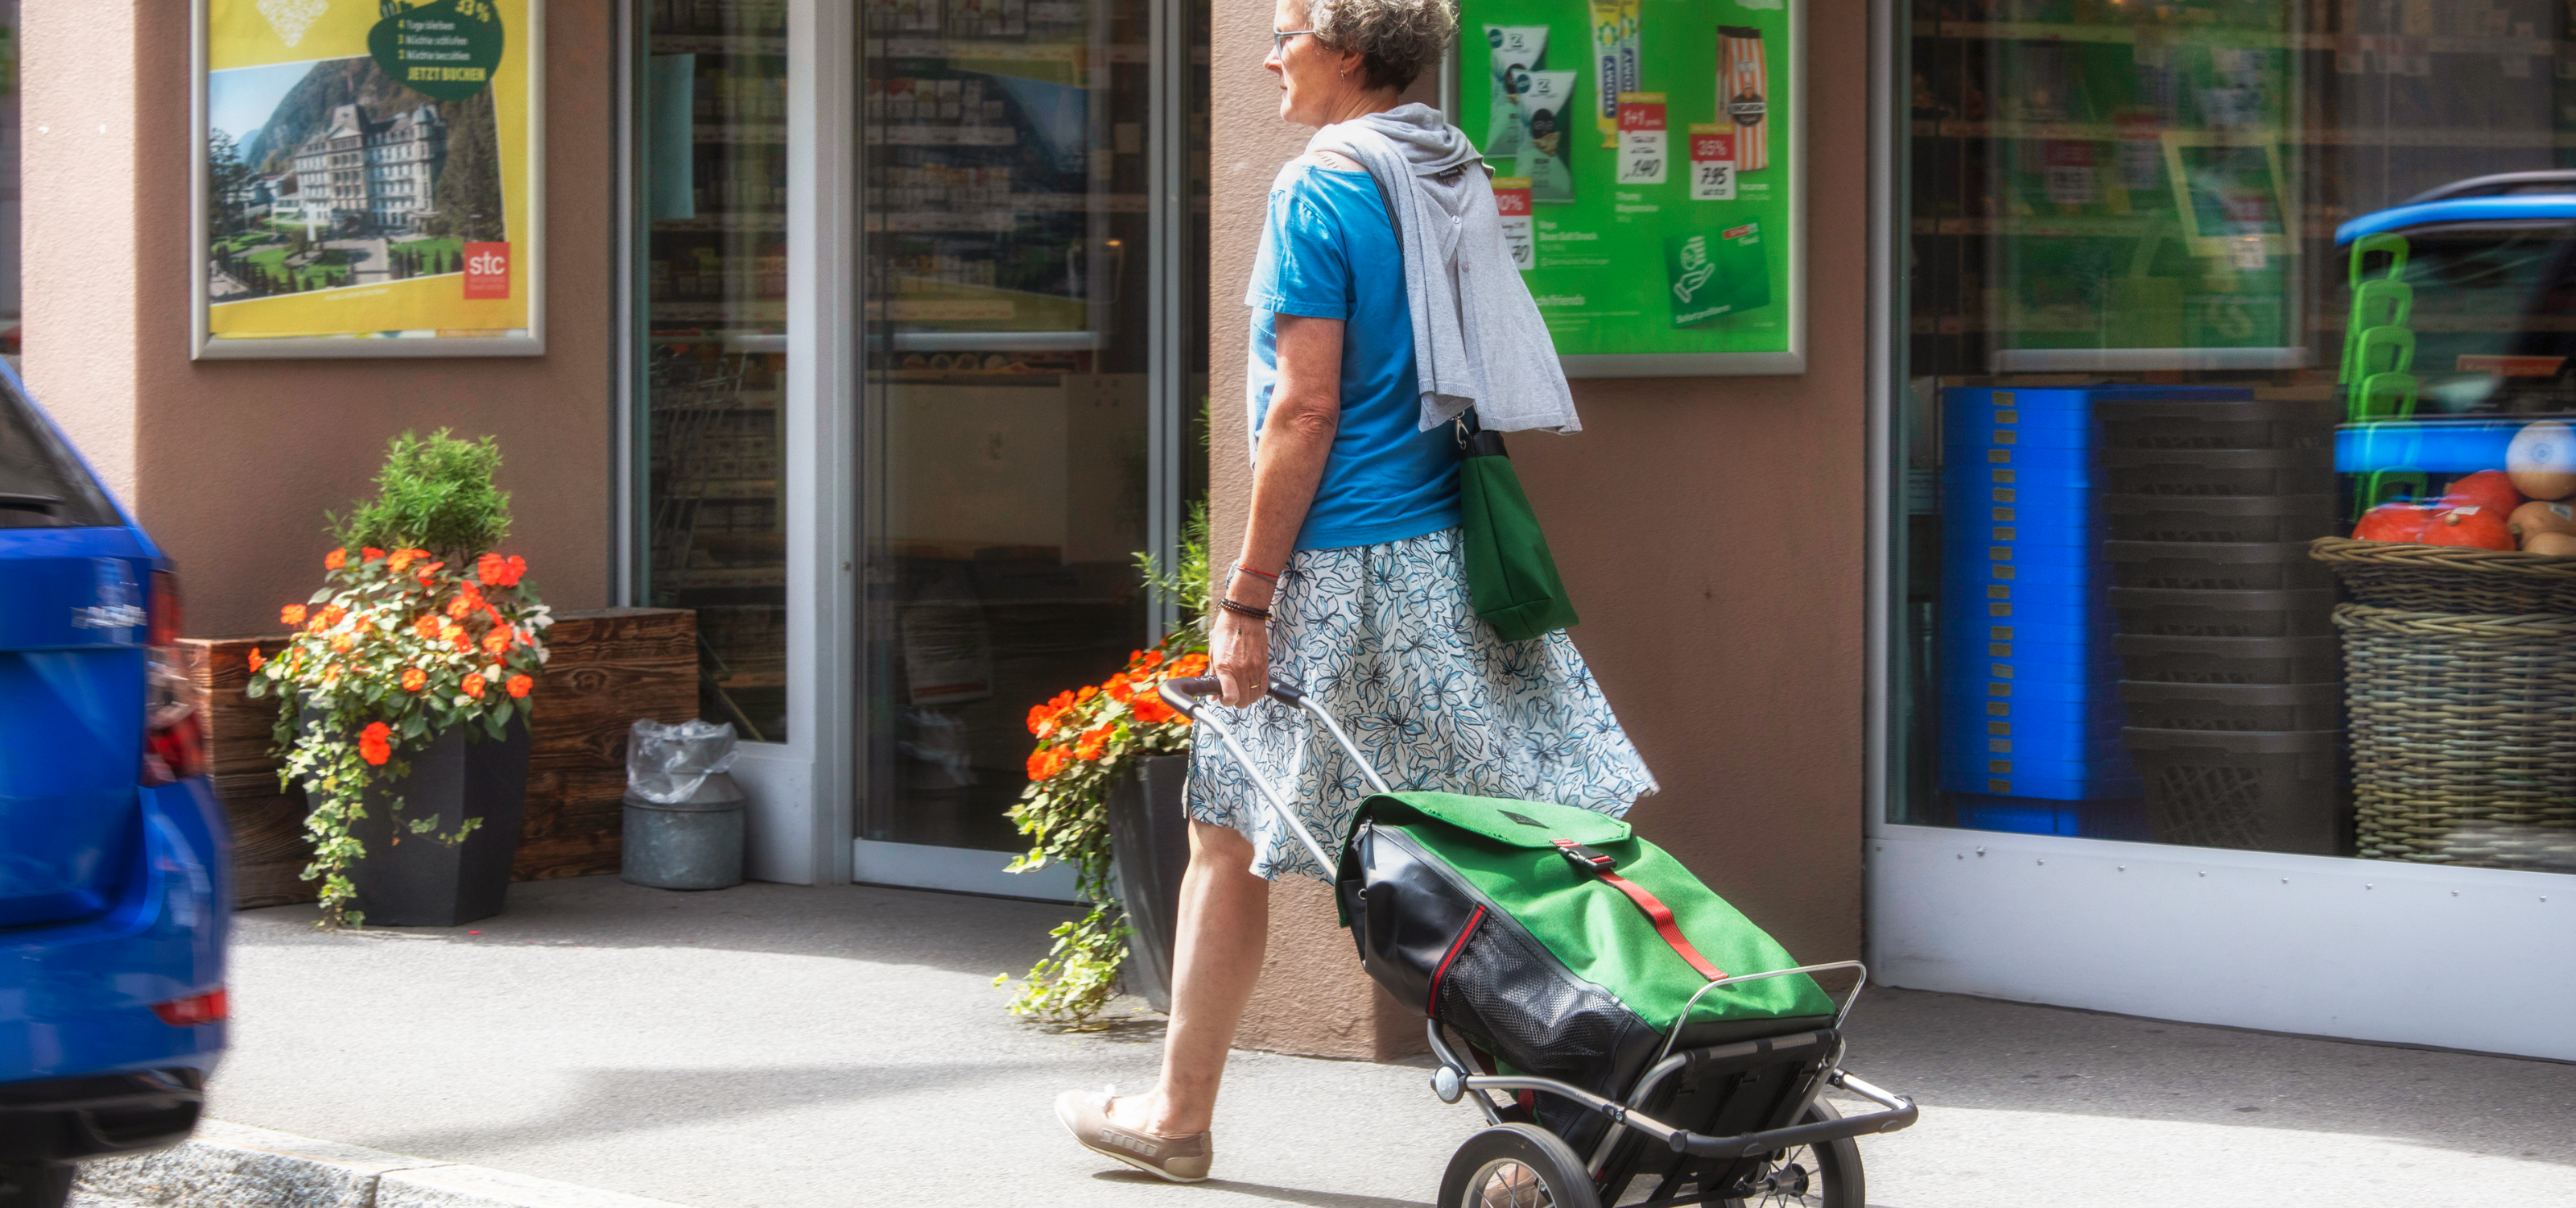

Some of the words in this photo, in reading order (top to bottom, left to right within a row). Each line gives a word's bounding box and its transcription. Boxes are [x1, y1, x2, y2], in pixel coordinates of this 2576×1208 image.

[407, 67, 440, 81] JETZT
[443, 68, 486, 81] BUCHEN
[1604, 58, 1615, 114] THOMY
[1623, 110, 1645, 126] 1+1
[1697, 139, 1728, 156] 35%
[469, 250, 506, 275] stc
